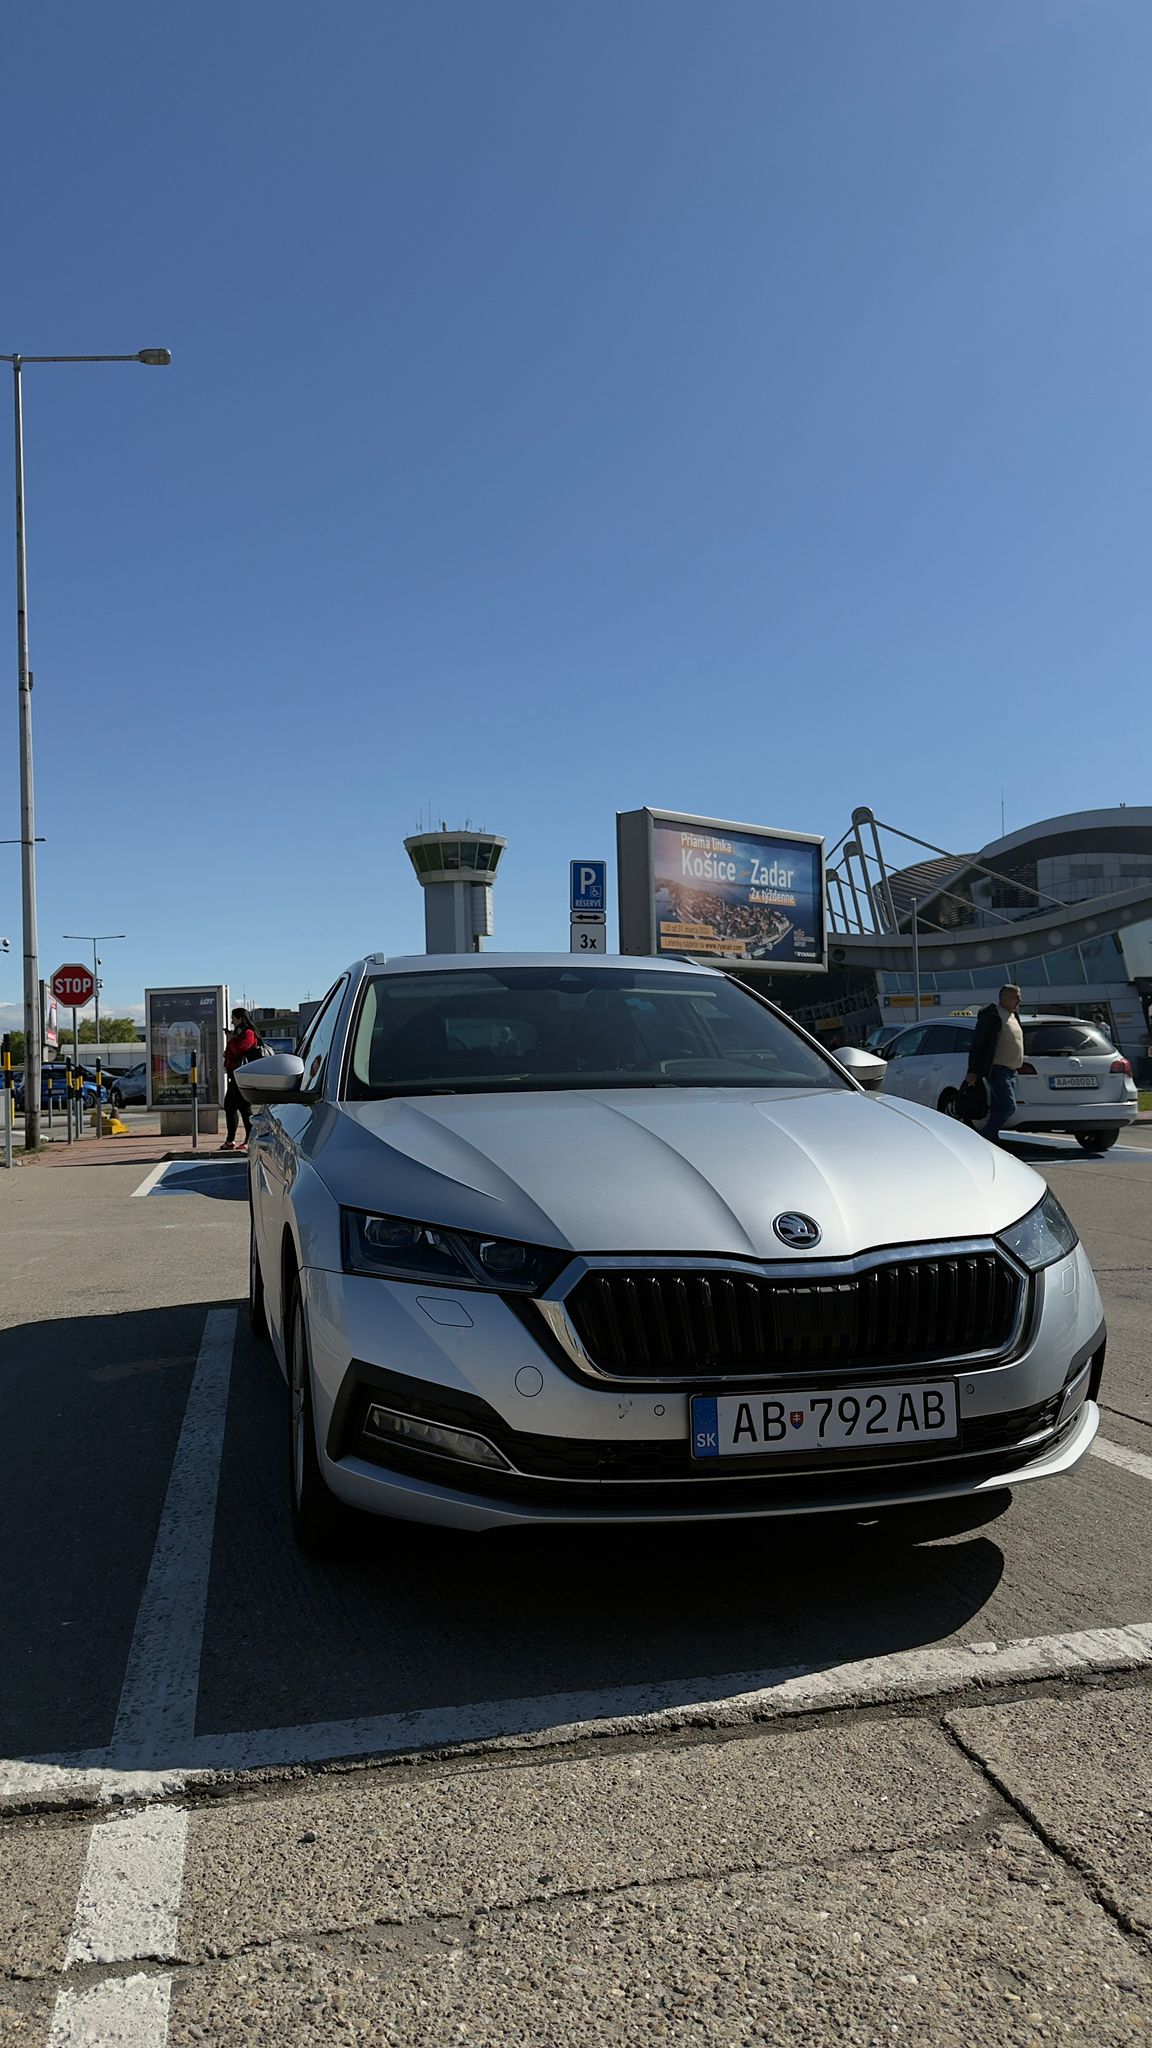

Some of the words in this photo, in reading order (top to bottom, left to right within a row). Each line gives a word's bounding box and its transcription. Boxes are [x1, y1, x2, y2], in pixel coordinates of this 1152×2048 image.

[681, 833, 711, 850] Priama
[712, 837, 732, 853] linka
[681, 849, 736, 881] Košice
[750, 858, 794, 889] Zadar
[581, 867, 597, 895] P
[750, 887, 760, 900] 2x
[761, 888, 795, 904] týždenne
[580, 933, 597, 949] 3x
[55, 977, 92, 994] STOP
[696, 1432, 716, 1448] SK
[732, 1401, 787, 1444] AB
